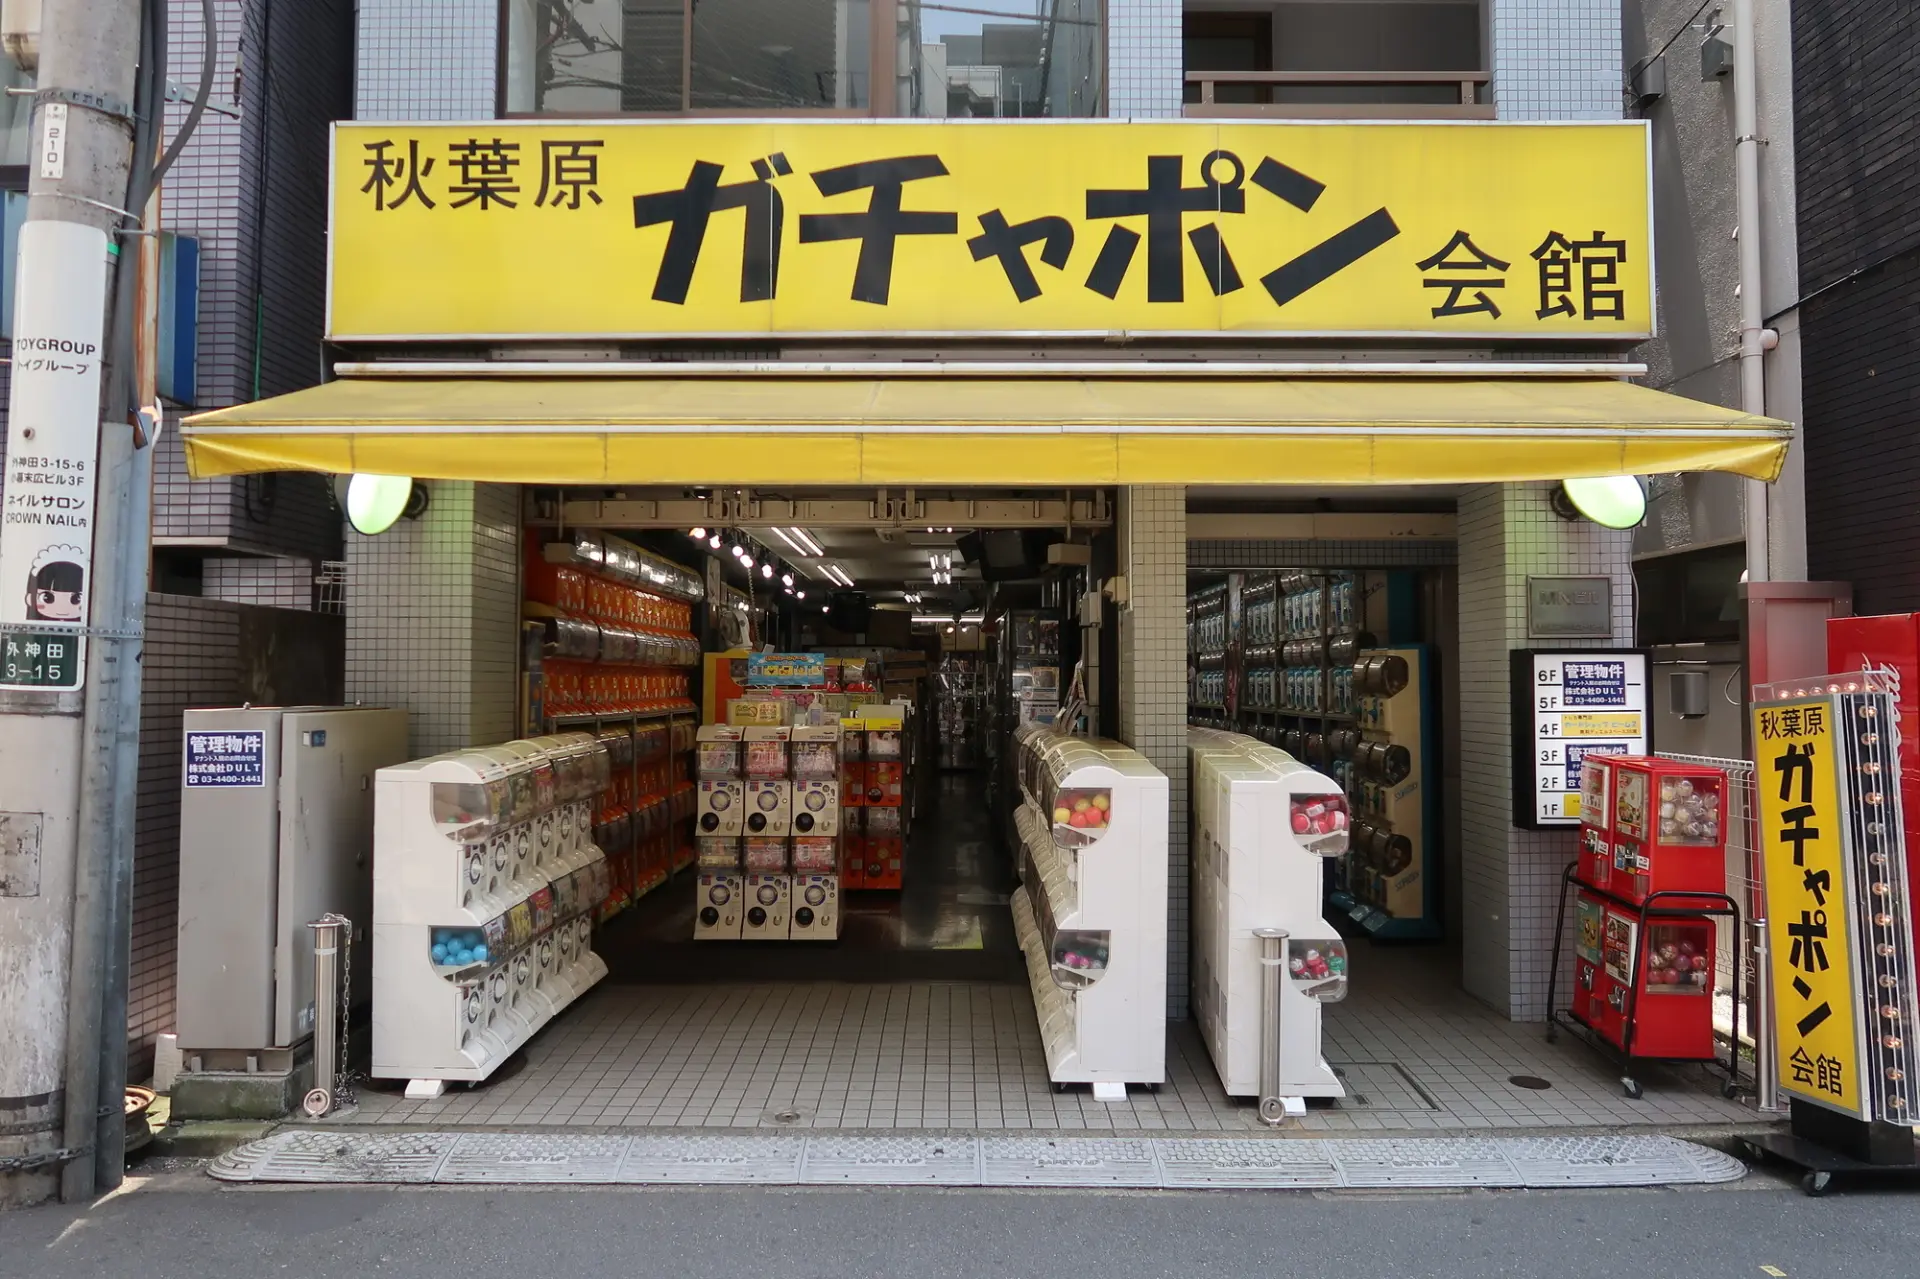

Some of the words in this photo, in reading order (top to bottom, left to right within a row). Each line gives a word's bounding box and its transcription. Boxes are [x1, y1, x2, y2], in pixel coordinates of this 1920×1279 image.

[47, 127, 60, 163] 210
[361, 138, 605, 211] 秋葉原
[632, 149, 1401, 307] ガチャポン
[1415, 229, 1627, 321] 会館
[6, 641, 64, 658] 外神田
[1538, 670, 1557, 682] 6F
[1565, 664, 1624, 679] 管理物件
[1565, 687, 1624, 695] 株式会社DULT
[1539, 697, 1558, 709] 5F
[1575, 696, 1625, 704] 03-4400-1441
[1539, 723, 1559, 735] 4F
[1760, 706, 1825, 741] 秋葉原
[190, 735, 261, 754] 管理物件
[1541, 751, 1558, 762] 3F
[189, 763, 261, 773] 株式会社DULT
[201, 775, 261, 783] 03-4400-1441
[1541, 777, 1558, 789] 2F
[1543, 804, 1558, 815] 1F
[1774, 741, 1833, 1038] ガチャポン
[1789, 1045, 1843, 1097] 会館
